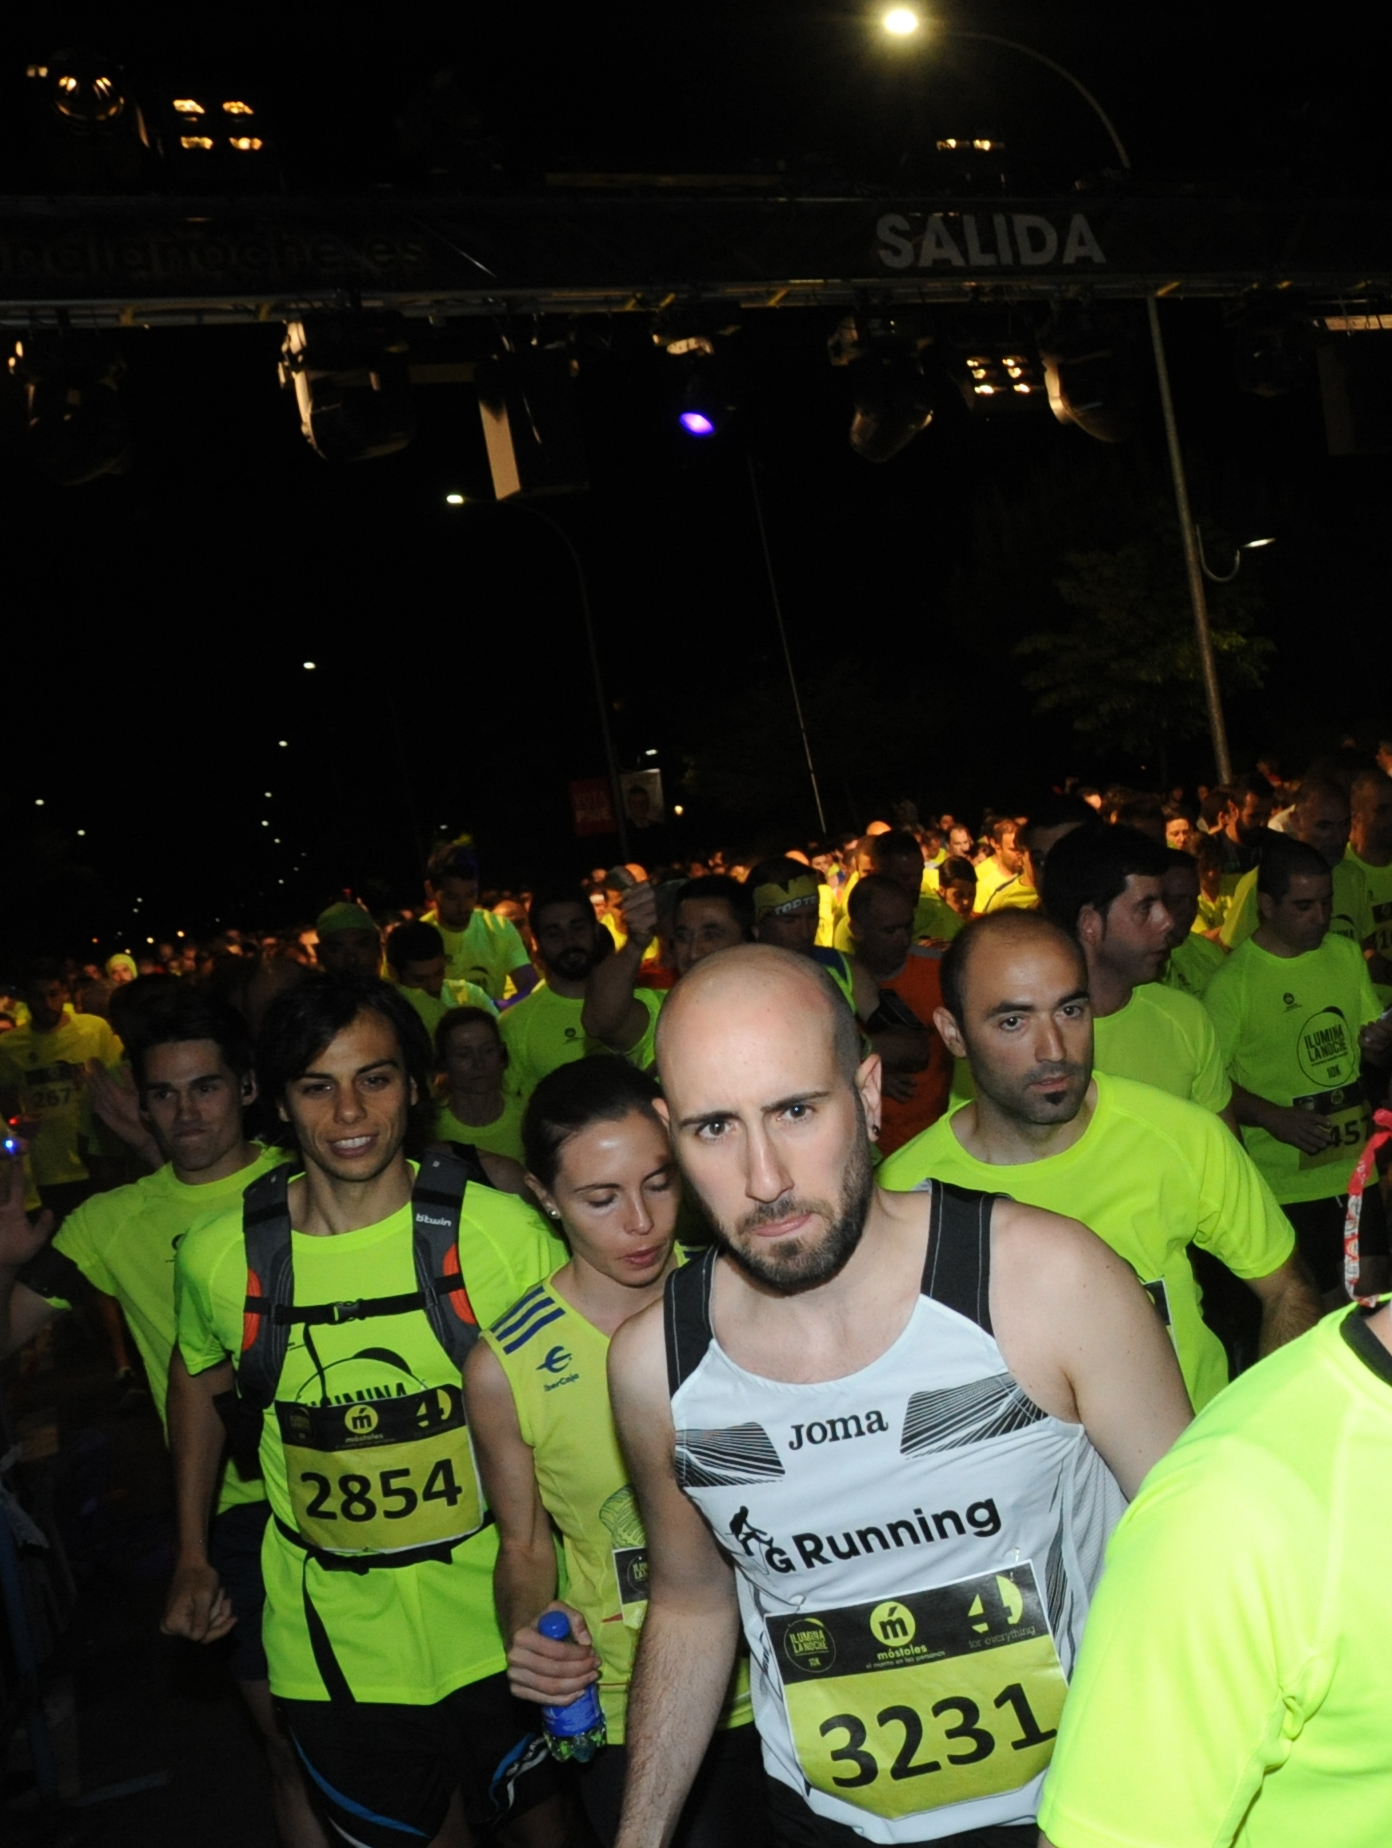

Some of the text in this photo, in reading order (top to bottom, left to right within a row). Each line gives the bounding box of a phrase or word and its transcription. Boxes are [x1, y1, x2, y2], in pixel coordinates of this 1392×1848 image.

[876, 213, 1107, 269] SALIDA
[301, 1458, 463, 1522] 2854
[792, 1498, 1001, 1569] Running
[877, 1644, 928, 1661] móstoles
[984, 1626, 1036, 1646] everything
[819, 1683, 1057, 1789] 3231
